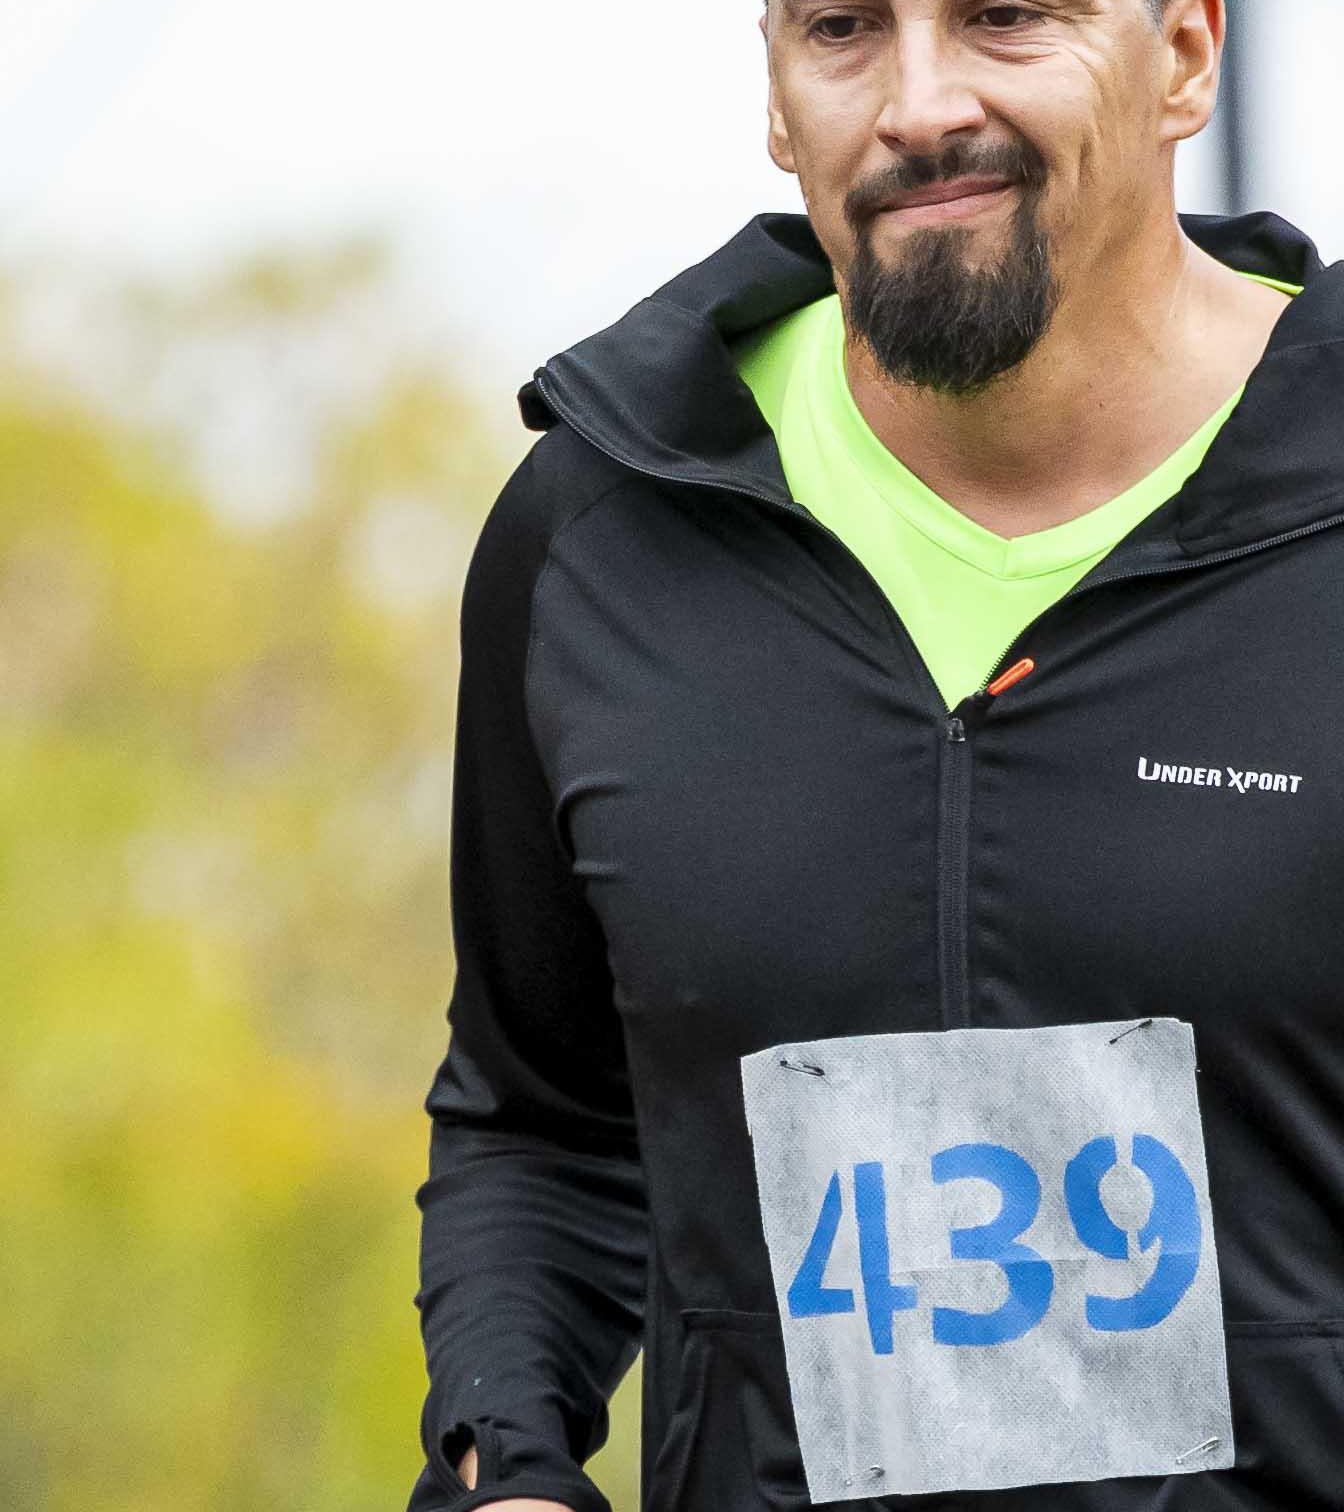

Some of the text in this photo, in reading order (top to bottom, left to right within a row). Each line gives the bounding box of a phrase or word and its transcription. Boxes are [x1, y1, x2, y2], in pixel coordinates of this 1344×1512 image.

[1137, 757, 1303, 793] UNDER XPORT
[787, 1134, 1202, 1355] 439
